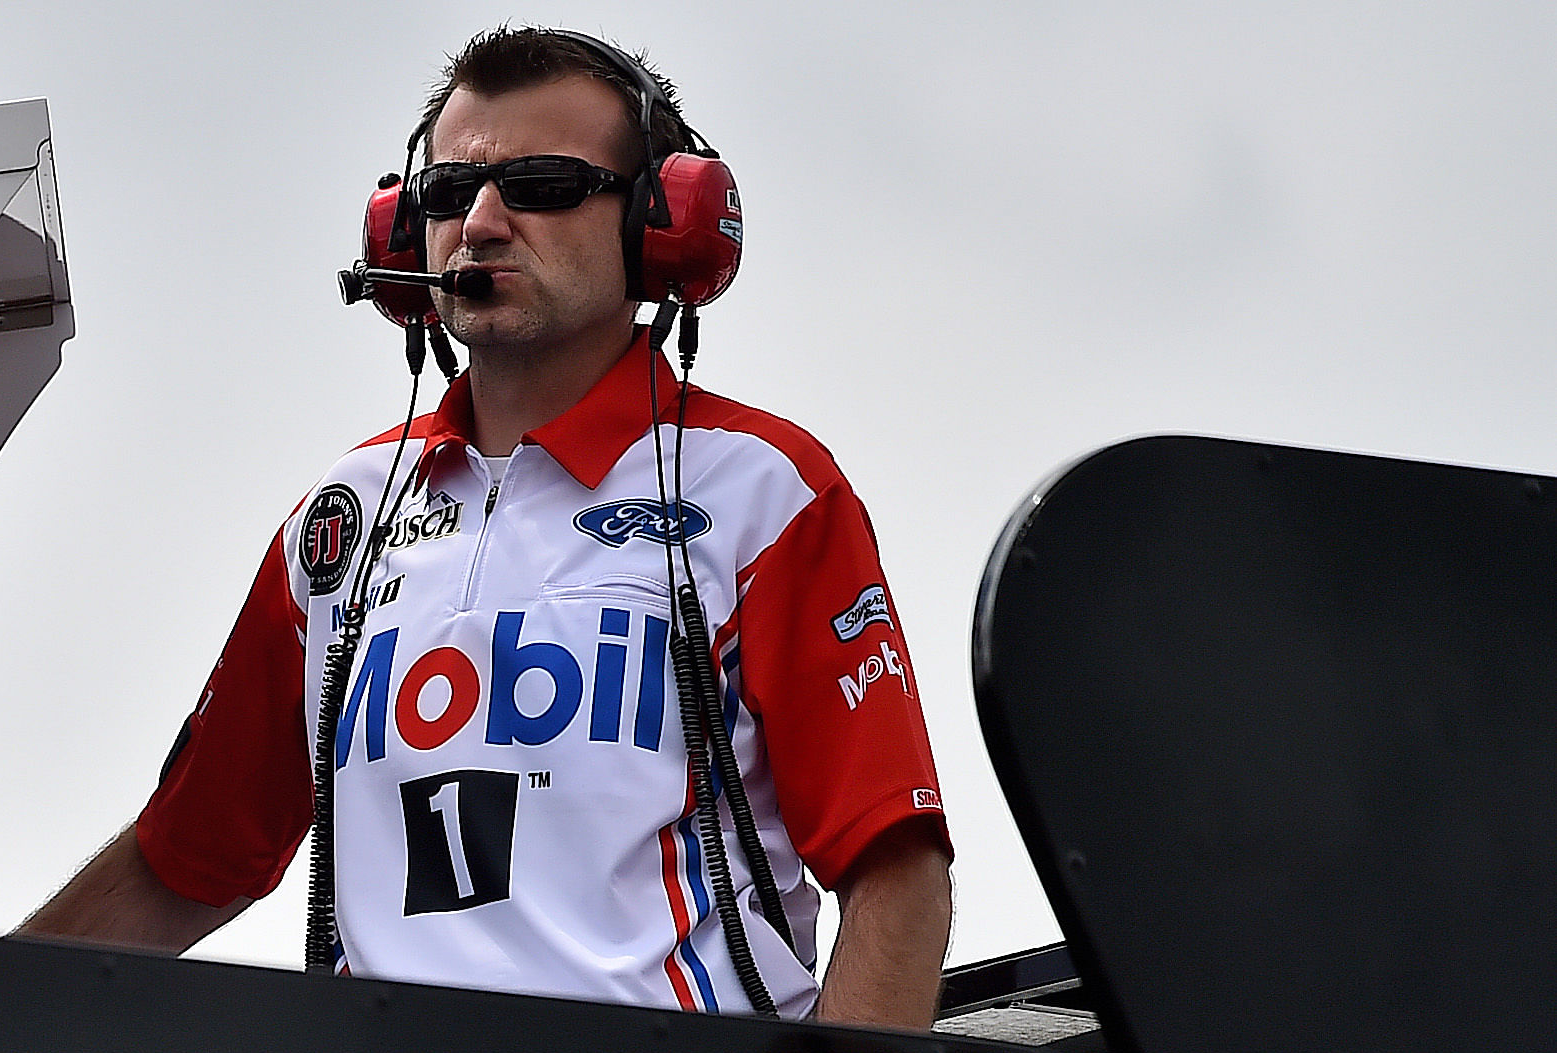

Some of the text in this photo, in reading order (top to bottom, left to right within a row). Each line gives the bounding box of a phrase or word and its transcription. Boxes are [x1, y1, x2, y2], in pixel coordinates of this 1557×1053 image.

[375, 502, 463, 559] USCH
[336, 608, 670, 772] Mobil
[429, 781, 475, 900] 1
